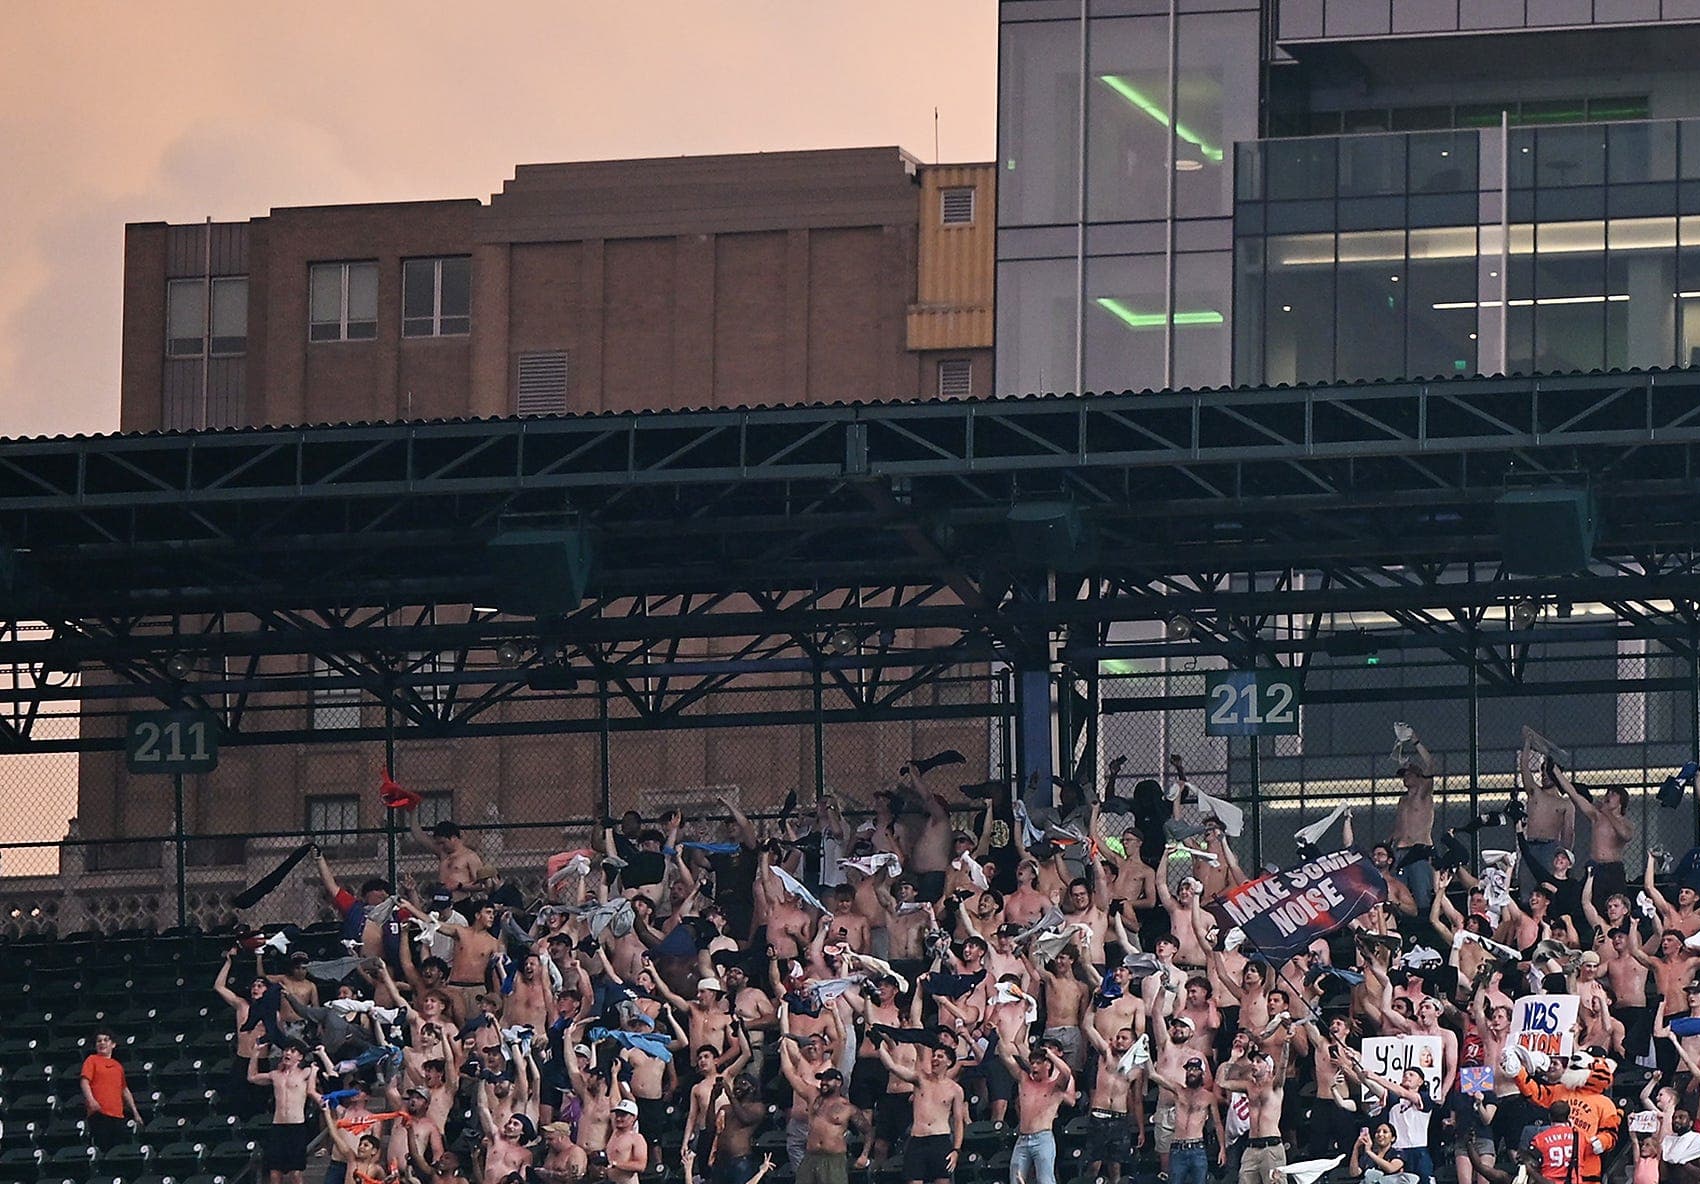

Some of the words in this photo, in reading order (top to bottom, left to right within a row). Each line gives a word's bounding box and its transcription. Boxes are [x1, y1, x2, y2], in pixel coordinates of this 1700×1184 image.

[1211, 683, 1294, 724] 212
[134, 721, 210, 762] 211
[1223, 876, 1290, 926] MAKE
[1285, 849, 1363, 888] SOME
[1269, 878, 1344, 937] NOISE
[1567, 1098, 1591, 1114] IGERS
